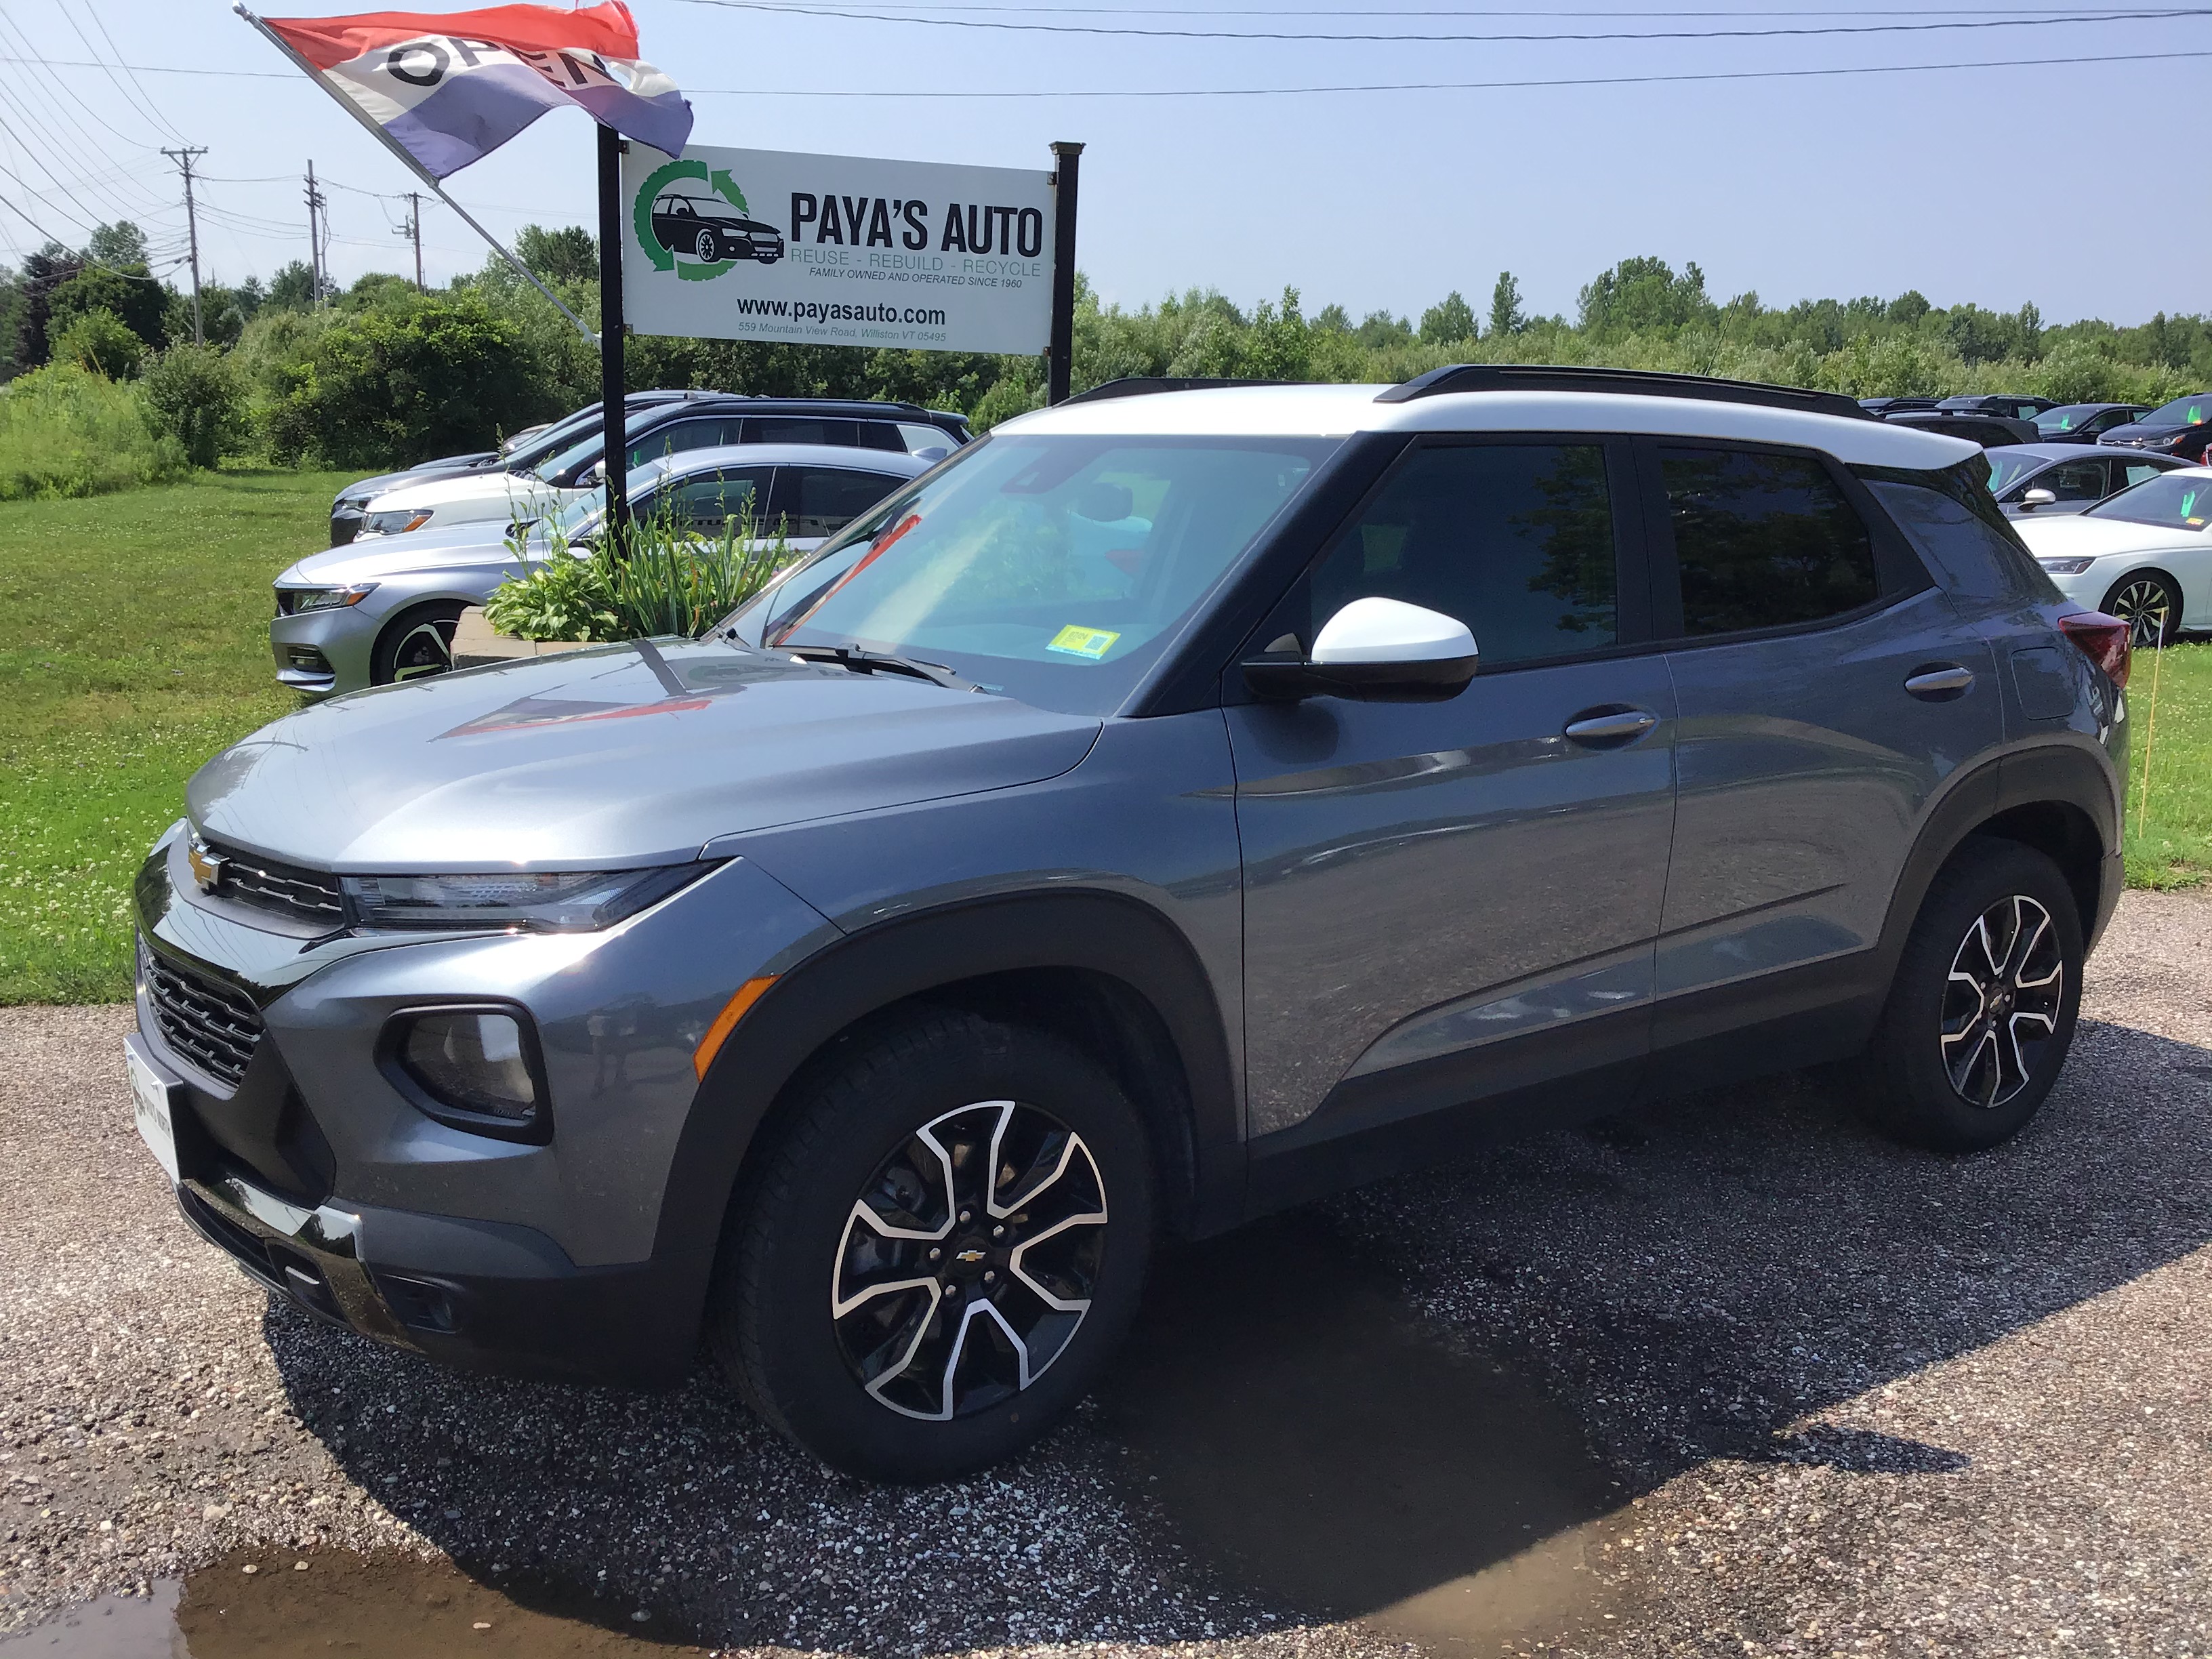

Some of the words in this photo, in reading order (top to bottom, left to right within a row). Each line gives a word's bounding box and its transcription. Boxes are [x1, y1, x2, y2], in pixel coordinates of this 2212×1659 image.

[791, 192, 928, 251] PAYA'S
[941, 203, 1042, 258] AUTO
[791, 248, 849, 265] REUSE
[869, 253, 943, 270] REBUILD
[963, 258, 1041, 276] RECYCLE
[809, 267, 845, 278] FAMILY
[847, 269, 886, 281] OWNED
[888, 272, 909, 282] AND
[912, 273, 966, 286] OPERATED
[968, 276, 998, 287] SINCE
[1001, 279, 1022, 289] 1960
[737, 298, 945, 325] www.payasauto.com
[738, 322, 756, 332] 559
[759, 323, 802, 334] Mountain
[805, 325, 828, 335] View
[830, 327, 857, 338] Road,
[861, 328, 899, 340] Williston
[902, 331, 916, 340] VT
[918, 331, 946, 342] 05495
